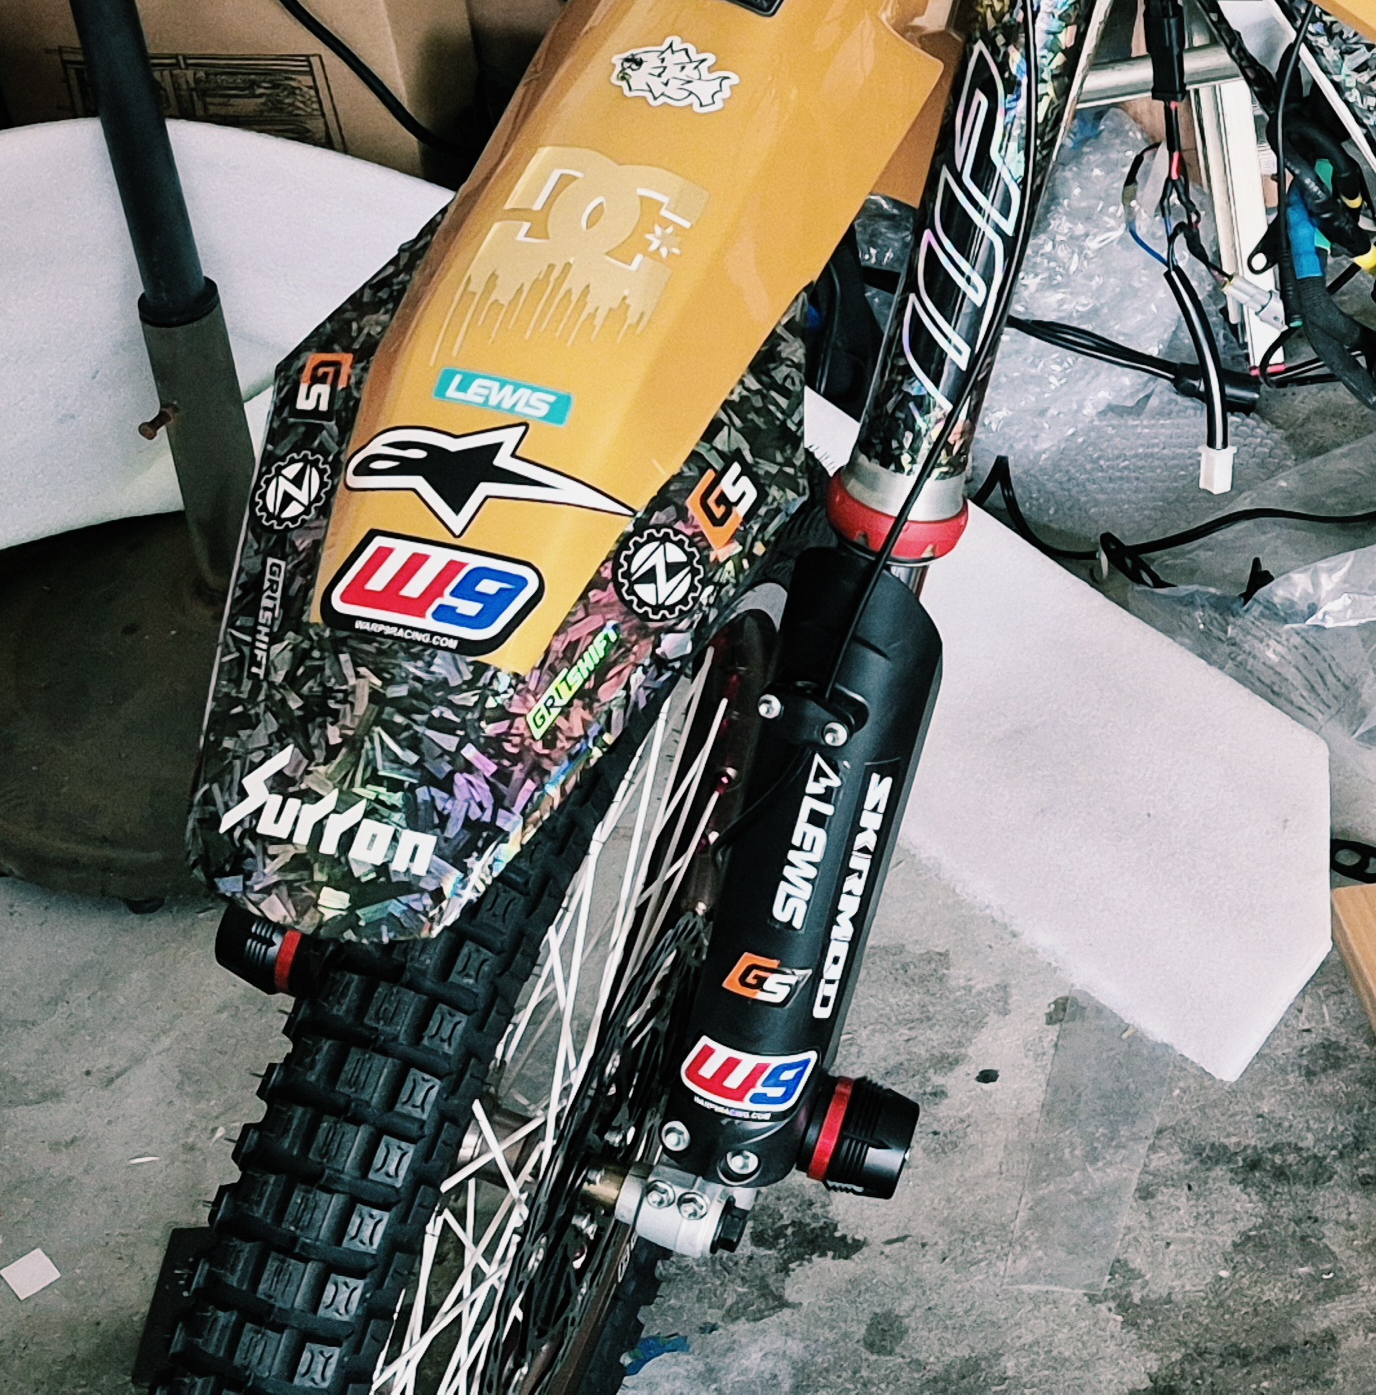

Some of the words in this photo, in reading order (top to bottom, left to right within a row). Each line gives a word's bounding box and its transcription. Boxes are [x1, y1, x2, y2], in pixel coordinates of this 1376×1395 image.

[444, 371, 558, 419] LEWIS
[247, 556, 286, 678] GRITSHIFT
[526, 626, 620, 737] GRITSHIFT
